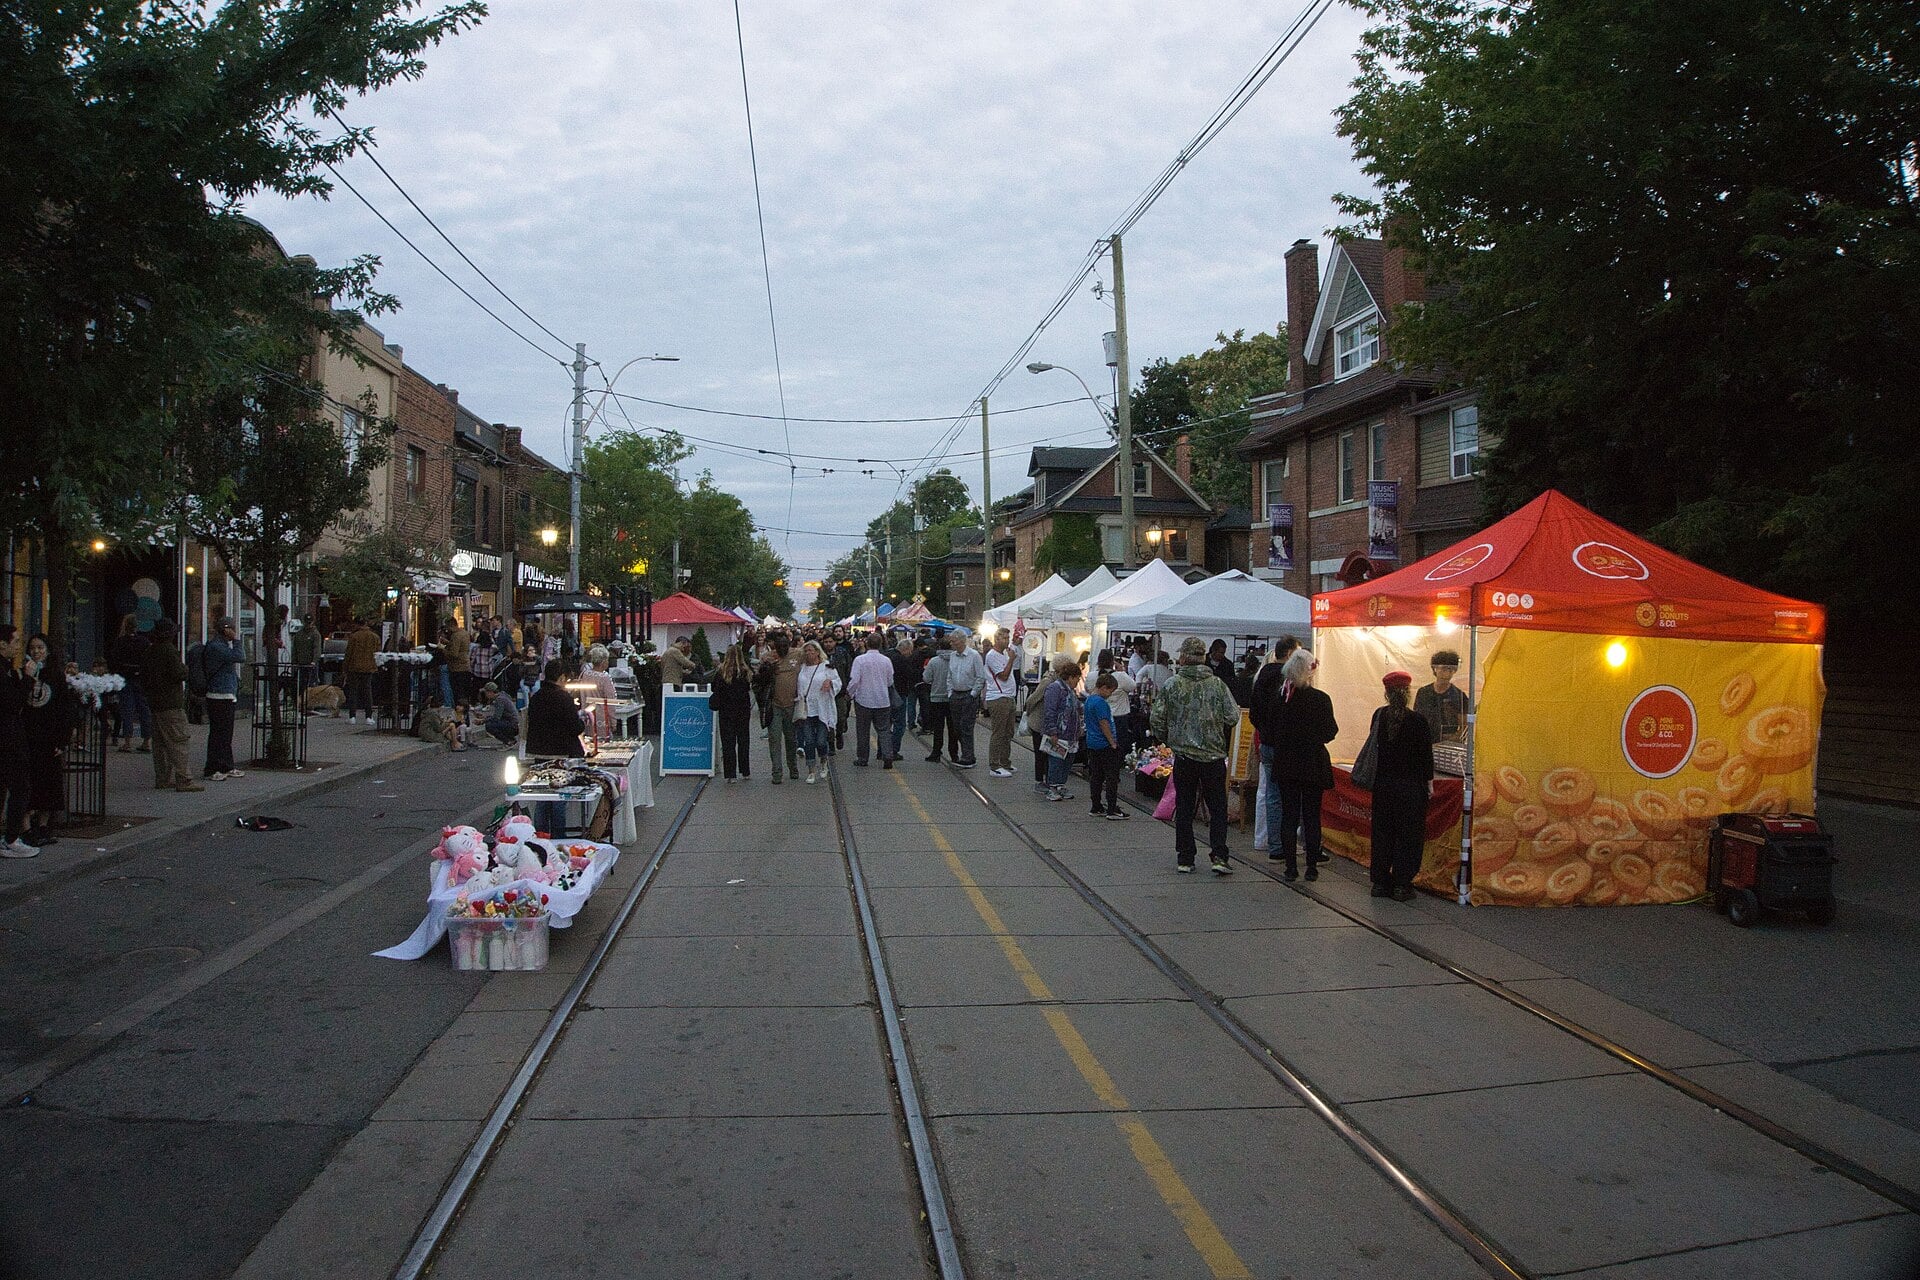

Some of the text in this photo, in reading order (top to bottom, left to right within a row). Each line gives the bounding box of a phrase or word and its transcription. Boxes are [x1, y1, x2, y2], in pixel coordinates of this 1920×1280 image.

[1372, 485, 1394, 493] MUSIC
[1659, 611, 1689, 621] DONUTS
[1665, 620, 1677, 628] CO.
[1659, 724, 1684, 732] DONUTS
